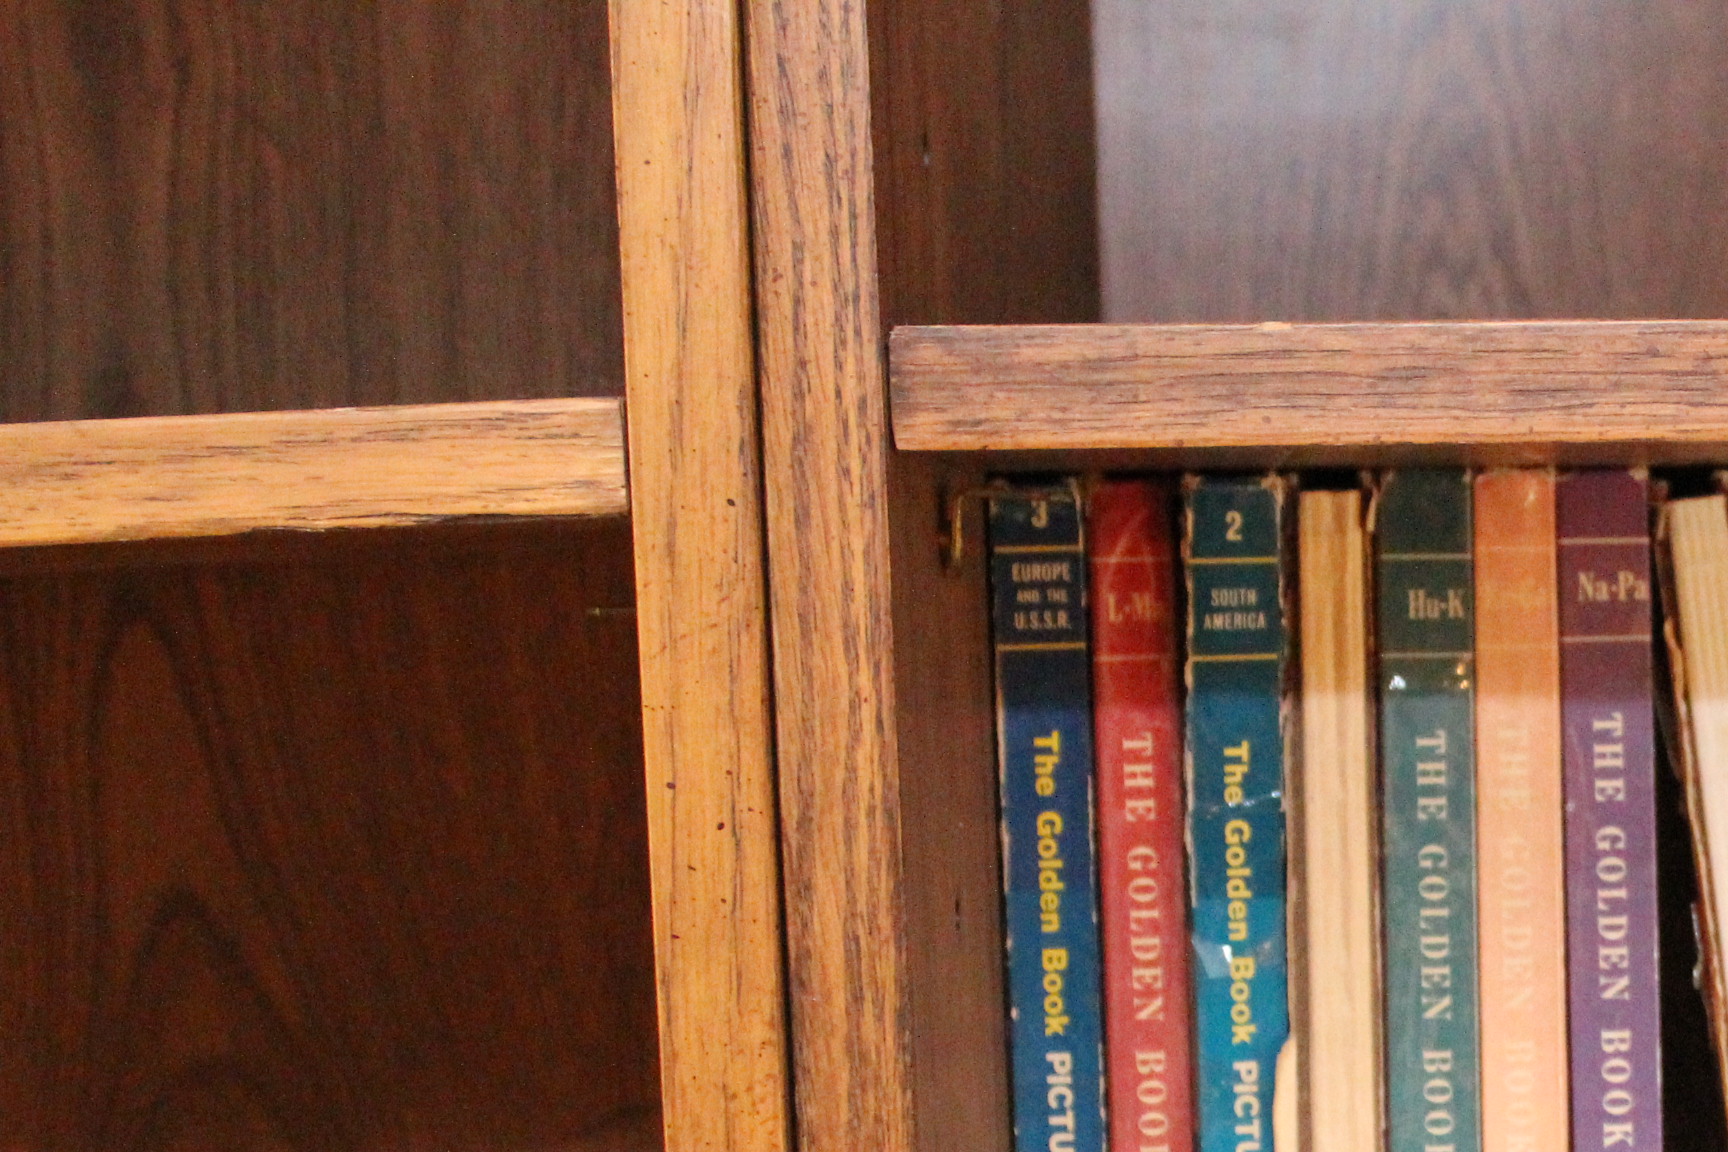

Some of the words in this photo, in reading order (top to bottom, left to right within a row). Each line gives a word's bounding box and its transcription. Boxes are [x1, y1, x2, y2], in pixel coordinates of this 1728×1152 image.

[1031, 499, 1047, 528] 3
[1225, 511, 1242, 541] 2
[1011, 562, 1072, 583] EUROPE
[1016, 589, 1039, 604] AND
[1047, 588, 1069, 603] THE
[1210, 588, 1258, 606] SOUTH
[1408, 589, 1465, 620] Hu-K
[1578, 571, 1650, 601] Na-Pa
[1014, 611, 1072, 630] U.S.S.R.
[1204, 611, 1267, 630] AMERICA
[1033, 730, 1061, 797] The
[1122, 731, 1157, 822] THE
[1223, 740, 1250, 806] The
[1415, 729, 1448, 821] THE
[1593, 711, 1625, 802] THE
[1036, 811, 1065, 933] Golden
[1224, 819, 1252, 941] Golden
[1127, 846, 1165, 1022] GOLDEN
[1417, 844, 1453, 1020] GOLDEN
[1596, 825, 1632, 1000] GOLDEN
[1041, 948, 1070, 1037] Book
[1230, 957, 1258, 1045] Book
[1600, 1028, 1635, 1149] BOOK
